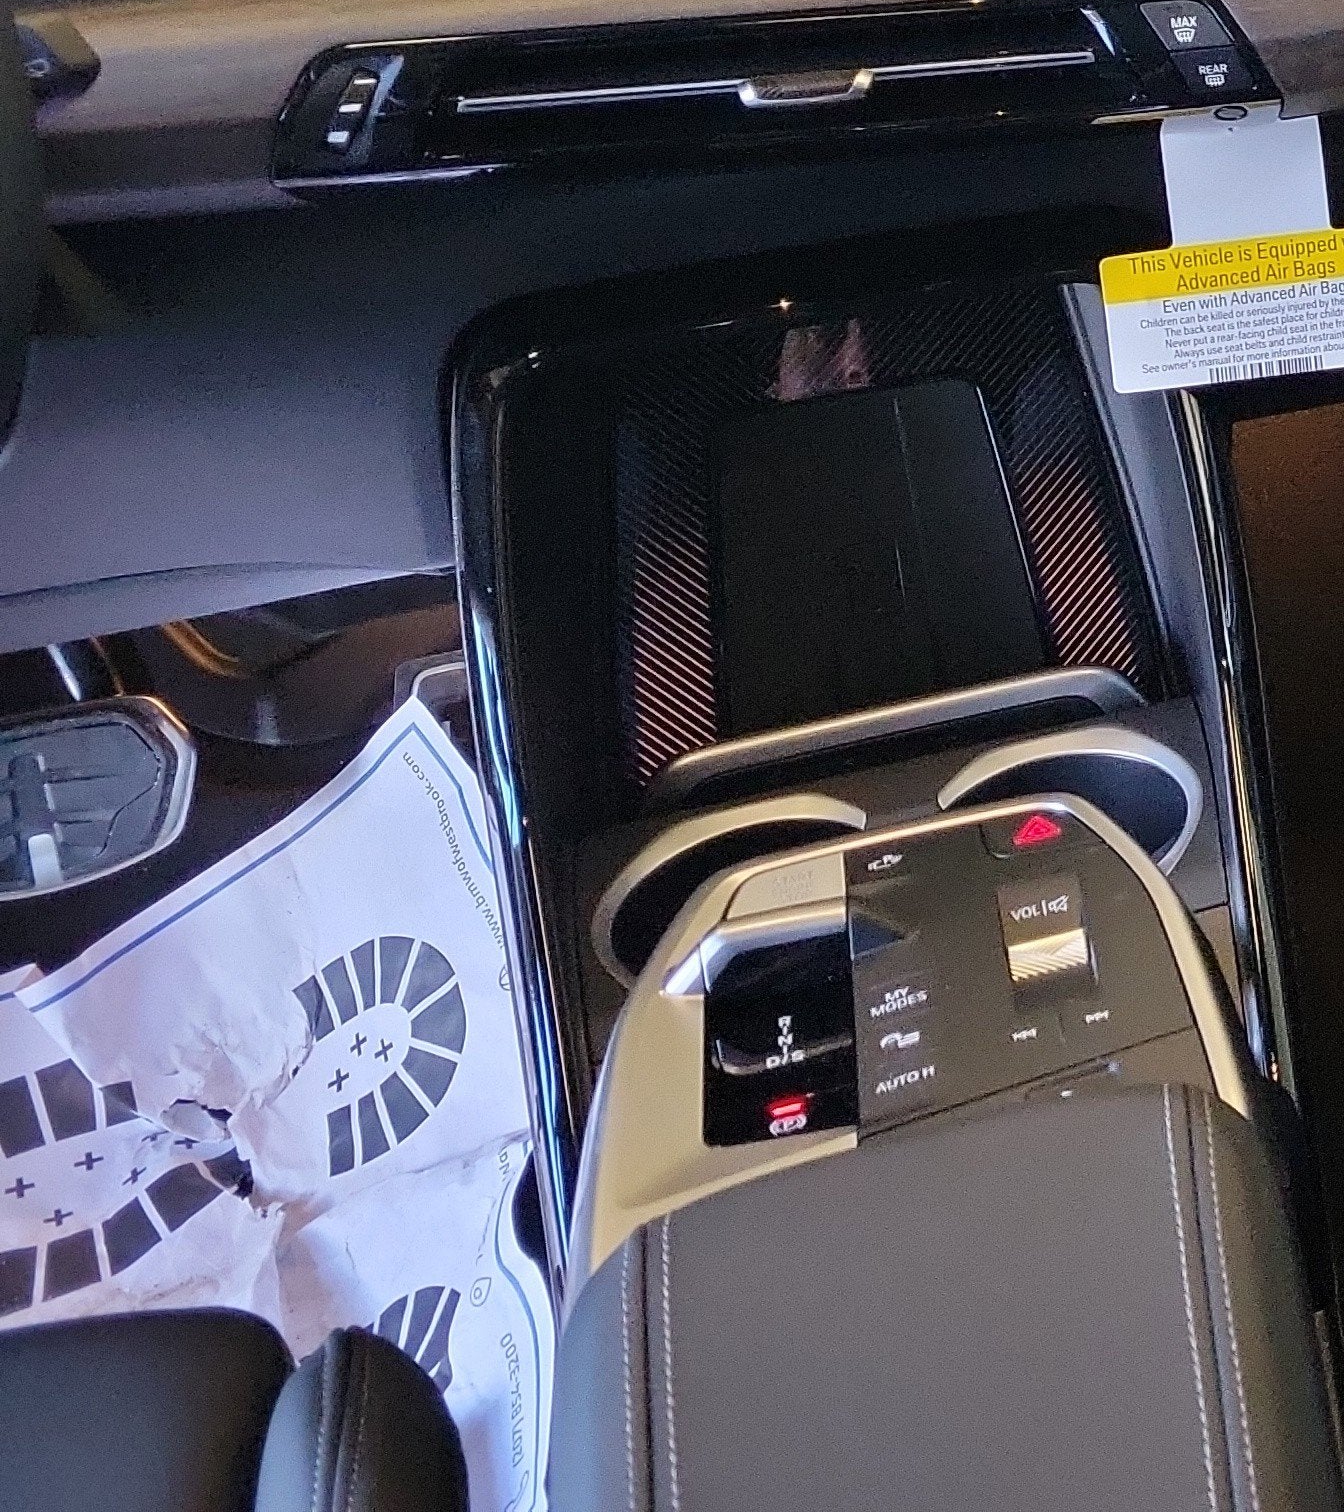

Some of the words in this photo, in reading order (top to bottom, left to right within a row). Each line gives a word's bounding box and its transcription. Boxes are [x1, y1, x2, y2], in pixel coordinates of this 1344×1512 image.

[1170, 15, 1198, 28] MAX
[1198, 63, 1229, 76] REAR
[1128, 255, 1165, 274] This
[1169, 246, 1233, 269] Vehicle
[1238, 244, 1252, 261] is
[1257, 234, 1338, 262] Equipped
[1175, 265, 1260, 291] Advanced
[1264, 262, 1289, 280] Air
[1292, 256, 1336, 280] Bags
[1162, 296, 1195, 313] Even
[1198, 293, 1227, 309] with
[1229, 285, 1295, 305] Advanced
[1298, 282, 1317, 297] Air
[1140, 316, 1177, 329] Children
[1179, 315, 1195, 324] can
[1197, 313, 1208, 322] be
[1210, 310, 1233, 320] killed
[1245, 304, 1285, 318] seriously
[1287, 300, 1317, 313] injured
[1319, 299, 1329, 310] by
[1331, 297, 1344, 306] the
[1164, 326, 1181, 337] The
[1183, 324, 1205, 335] back
[1206, 322, 1225, 332] seat
[1226, 321, 1234, 330] is
[1236, 319, 1250, 328] the
[1252, 315, 1279, 327] safest
[1280, 312, 1304, 325] place
[1306, 310, 1318, 320] for
[1164, 336, 1191, 348] Never
[1192, 335, 1208, 346] put
[1216, 328, 1265, 344] rear-facing
[1266, 326, 1287, 336] child
[1289, 323, 1308, 333] seat
[1309, 322, 1318, 331] in
[1319, 320, 1333, 329] the
[1173, 347, 1205, 360] Always
[1206, 346, 1223, 355] use
[1224, 342, 1243, 352] seat
[1244, 339, 1266, 350] belts
[1268, 337, 1284, 347] and
[1286, 334, 1307, 345] child
[1141, 362, 1160, 374] See
[1161, 358, 1196, 371] owner's
[1198, 354, 1231, 367] manual
[1232, 352, 1244, 363] for
[1246, 352, 1270, 361] more
[1271, 343, 1321, 358] information
[870, 990, 928, 1018] MODES
[885, 986, 909, 1003] MY
[778, 1033, 793, 1047] N
[876, 1070, 920, 1094] AUTO
